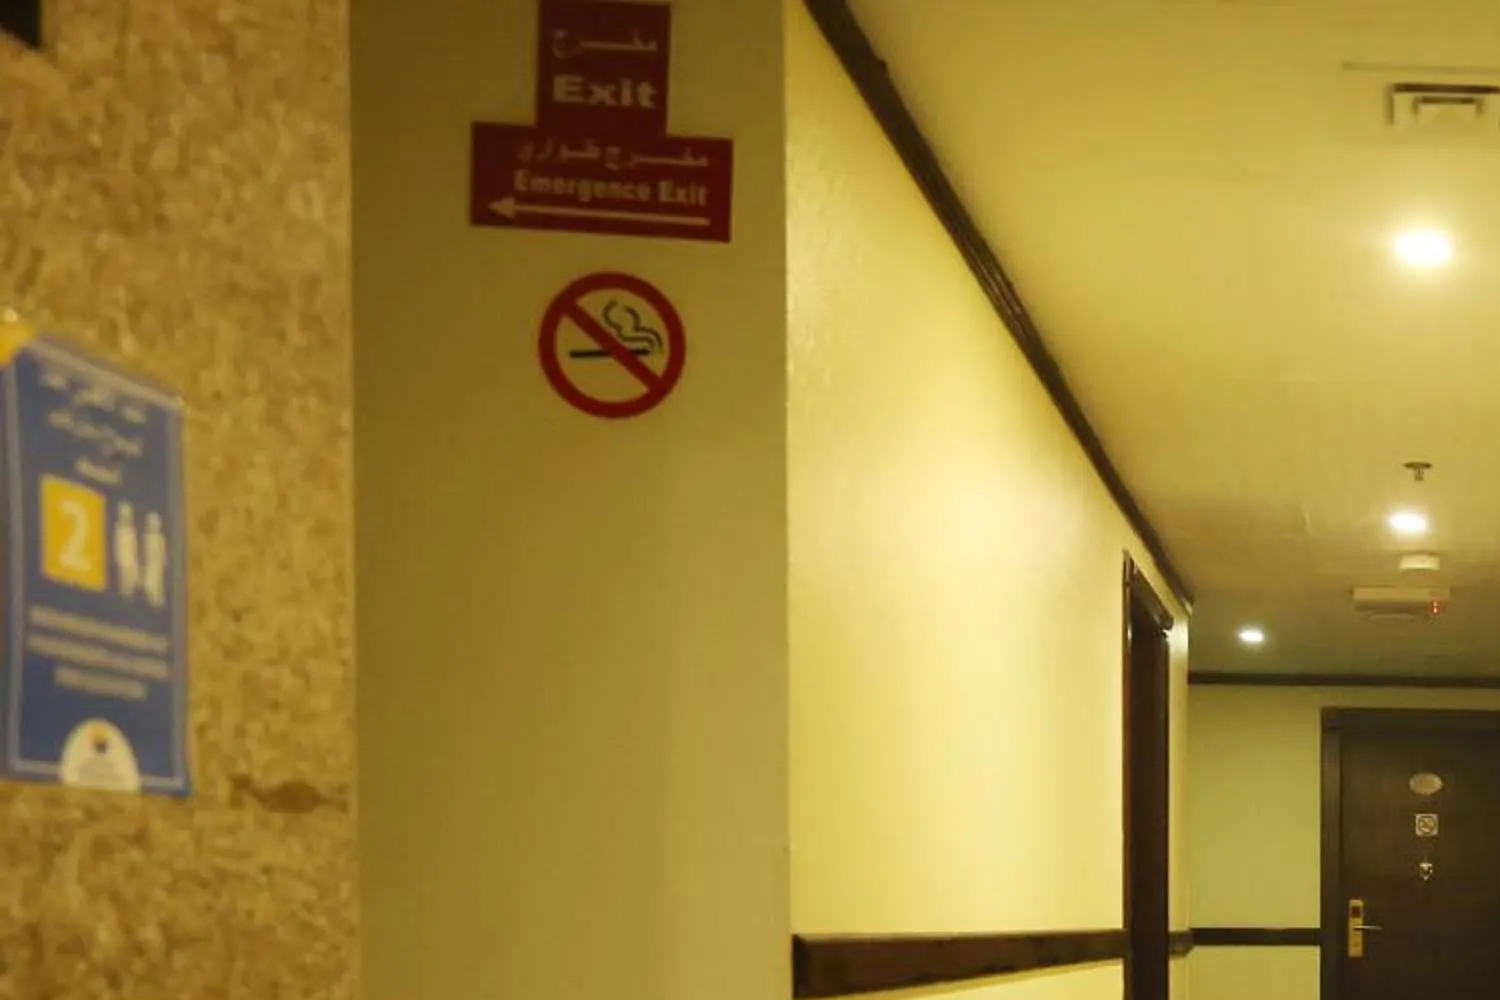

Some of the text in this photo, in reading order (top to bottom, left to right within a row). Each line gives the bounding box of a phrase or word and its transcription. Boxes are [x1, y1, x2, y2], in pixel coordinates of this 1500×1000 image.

[552, 73, 657, 109] Exit
[658, 179, 710, 206] Exit
[57, 497, 91, 573] 2
